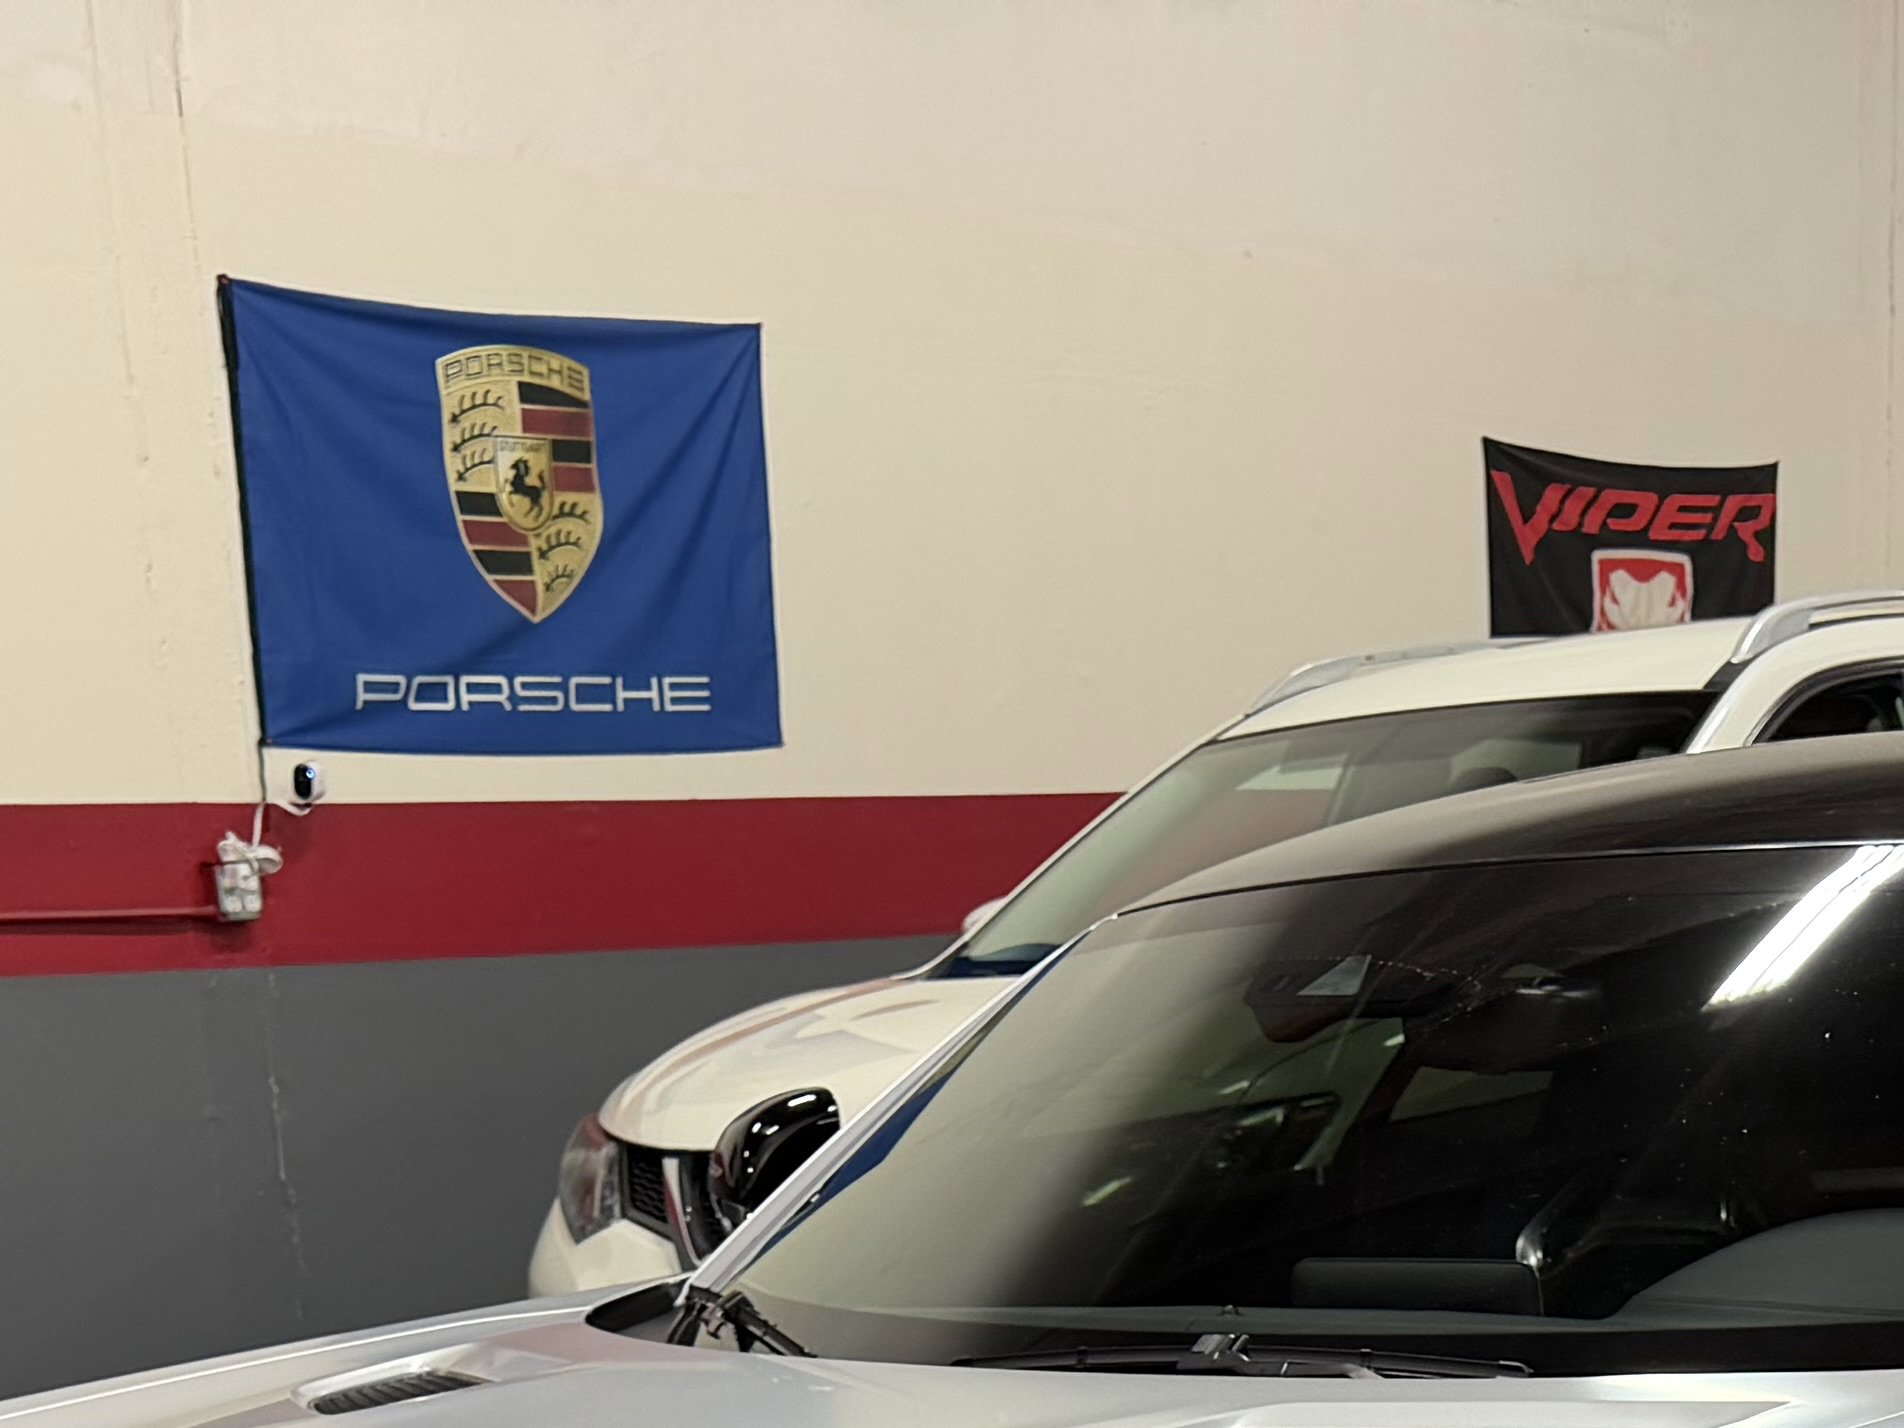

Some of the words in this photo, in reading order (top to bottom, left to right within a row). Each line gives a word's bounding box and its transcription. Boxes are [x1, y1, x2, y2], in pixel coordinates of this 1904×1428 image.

[444, 352, 585, 393] PORSCHE
[1490, 470, 1777, 565] VIPER
[354, 671, 712, 713] PORSCHE
